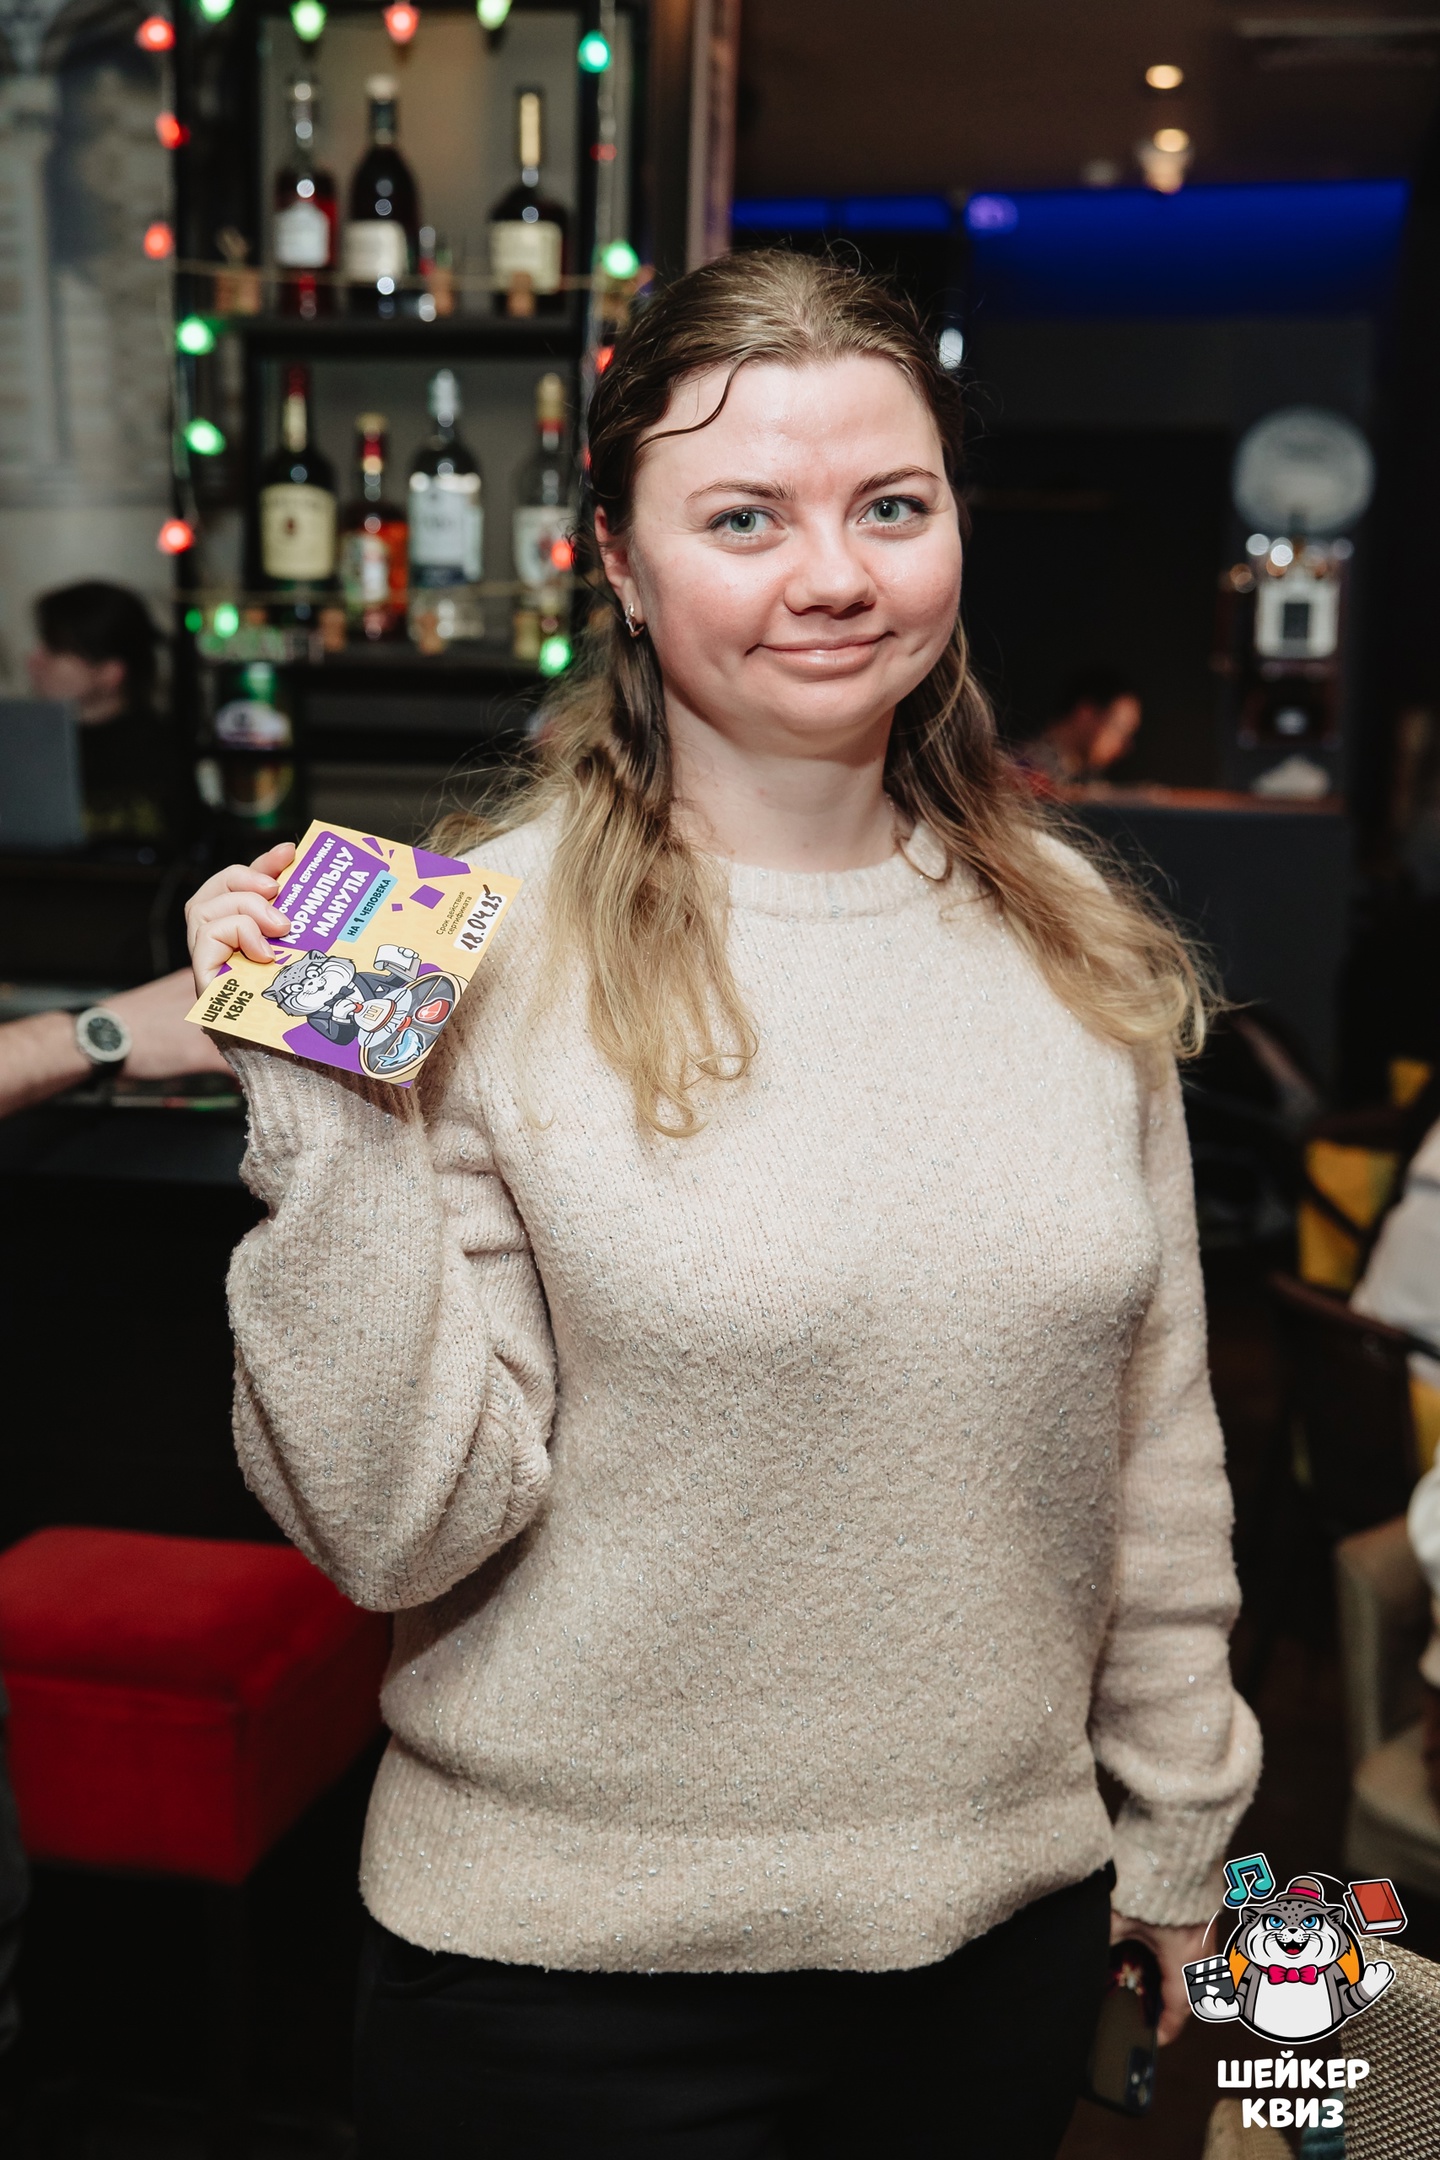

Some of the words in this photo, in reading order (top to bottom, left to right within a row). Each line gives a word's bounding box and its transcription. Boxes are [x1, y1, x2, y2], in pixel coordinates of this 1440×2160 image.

[278, 883, 304, 914] ОЧНЫЙ
[299, 837, 336, 883] СЕРТИФИКАТ
[279, 846, 354, 945] КОРМИЛЬЦУ
[312, 870, 370, 938] МАНУЛА
[347, 924, 360, 936] НА
[360, 879, 391, 916] ЧЕЛОВЕКА
[436, 919, 449, 935] Срок
[447, 891, 465, 919] действия
[447, 896, 472, 935] сертификата
[461, 884, 502, 950] 18.04.25
[201, 978, 240, 1023] ШЕЙКЕР
[223, 990, 254, 1021] КВИЗ
